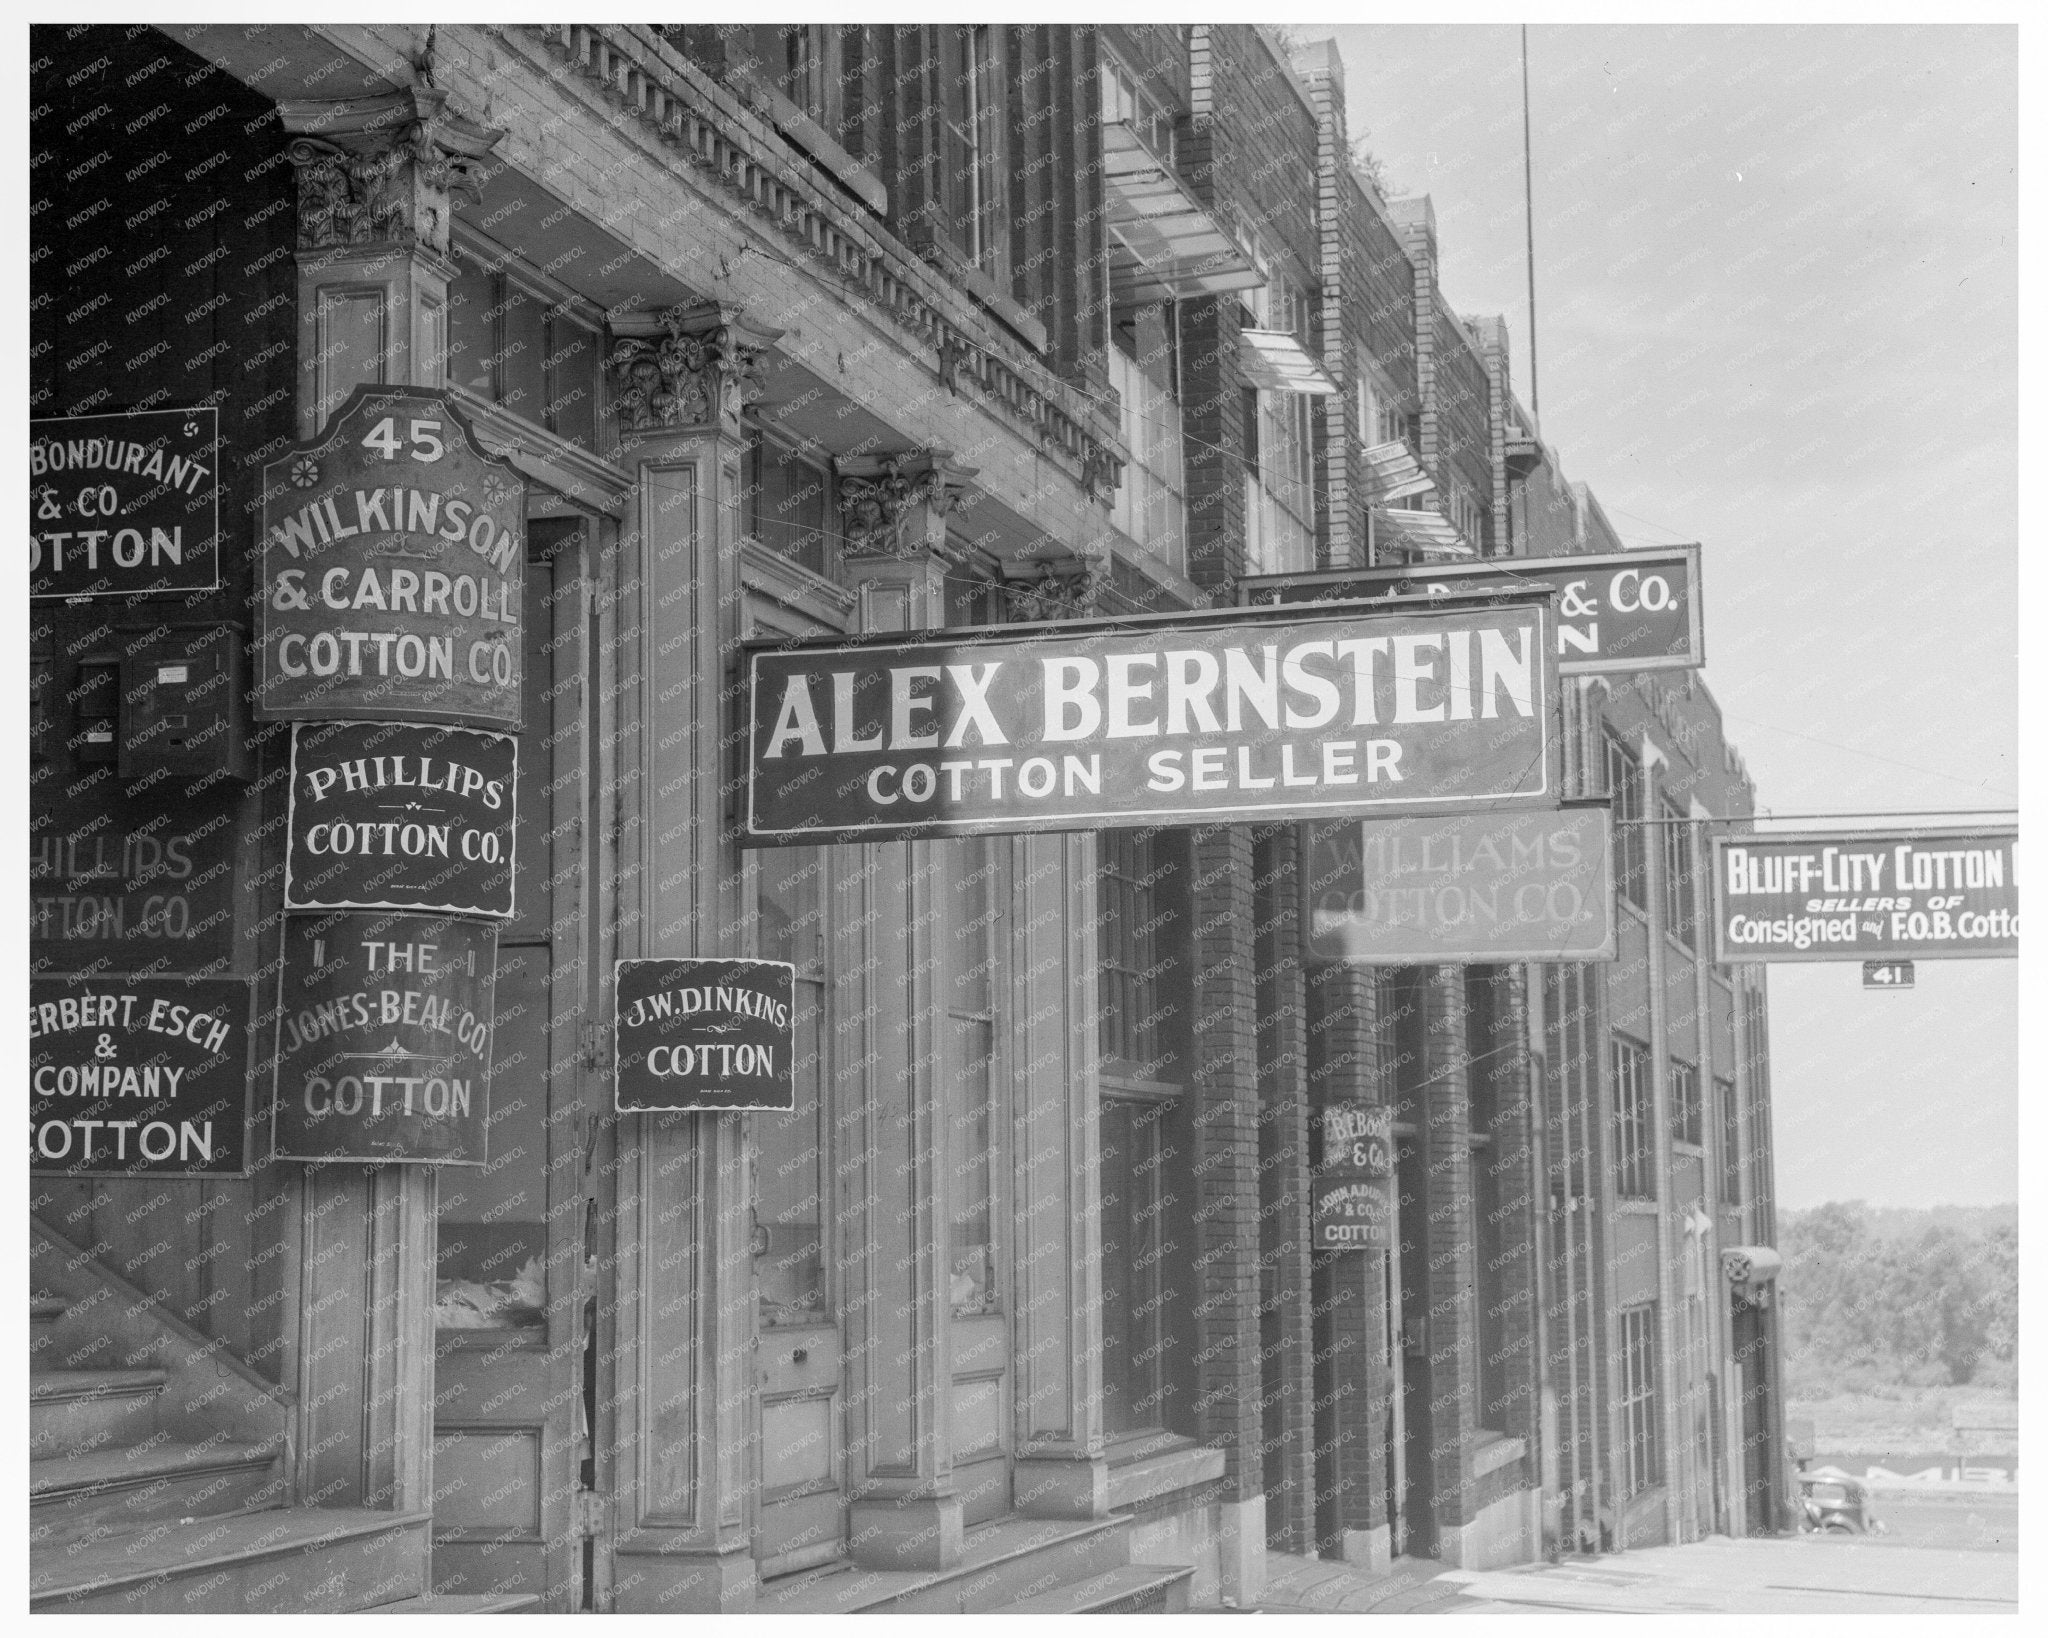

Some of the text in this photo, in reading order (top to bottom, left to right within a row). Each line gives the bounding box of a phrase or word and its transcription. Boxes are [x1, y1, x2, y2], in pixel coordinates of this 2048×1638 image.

[361, 417, 444, 462] 45
[31, 439, 211, 494] BONDURANT
[37, 486, 127, 519] & CO.
[269, 488, 519, 576] WILKINSON
[272, 566, 517, 624] & CARROLL
[1561, 580, 1598, 618] &
[278, 632, 453, 679] COTTON
[763, 626, 1534, 758] ALEX BERNSTEIN
[305, 755, 504, 810] PHILLIPS
[867, 738, 1404, 805] COTTON SELLER
[307, 822, 505, 864] COTTON CO.
[1326, 832, 1581, 874] WILLIAMS
[30, 895, 189, 940] TTON CO
[1318, 886, 1498, 927] COTTON
[1805, 895, 1965, 912] SELLERS OF
[1728, 913, 1857, 949] Consigned
[361, 941, 438, 974] THE
[1872, 965, 1902, 984] 41
[94, 1033, 118, 1058] &
[147, 998, 231, 1054] ESCH
[286, 990, 486, 1060] JONES-BEAL CO.
[34, 1065, 185, 1098] COMPANY
[647, 1043, 773, 1078] COTTON
[304, 1075, 471, 1118] COTTON
[30, 1119, 212, 1161] OTTON
[1353, 1142, 1367, 1167] &
[1345, 1203, 1355, 1217] &
